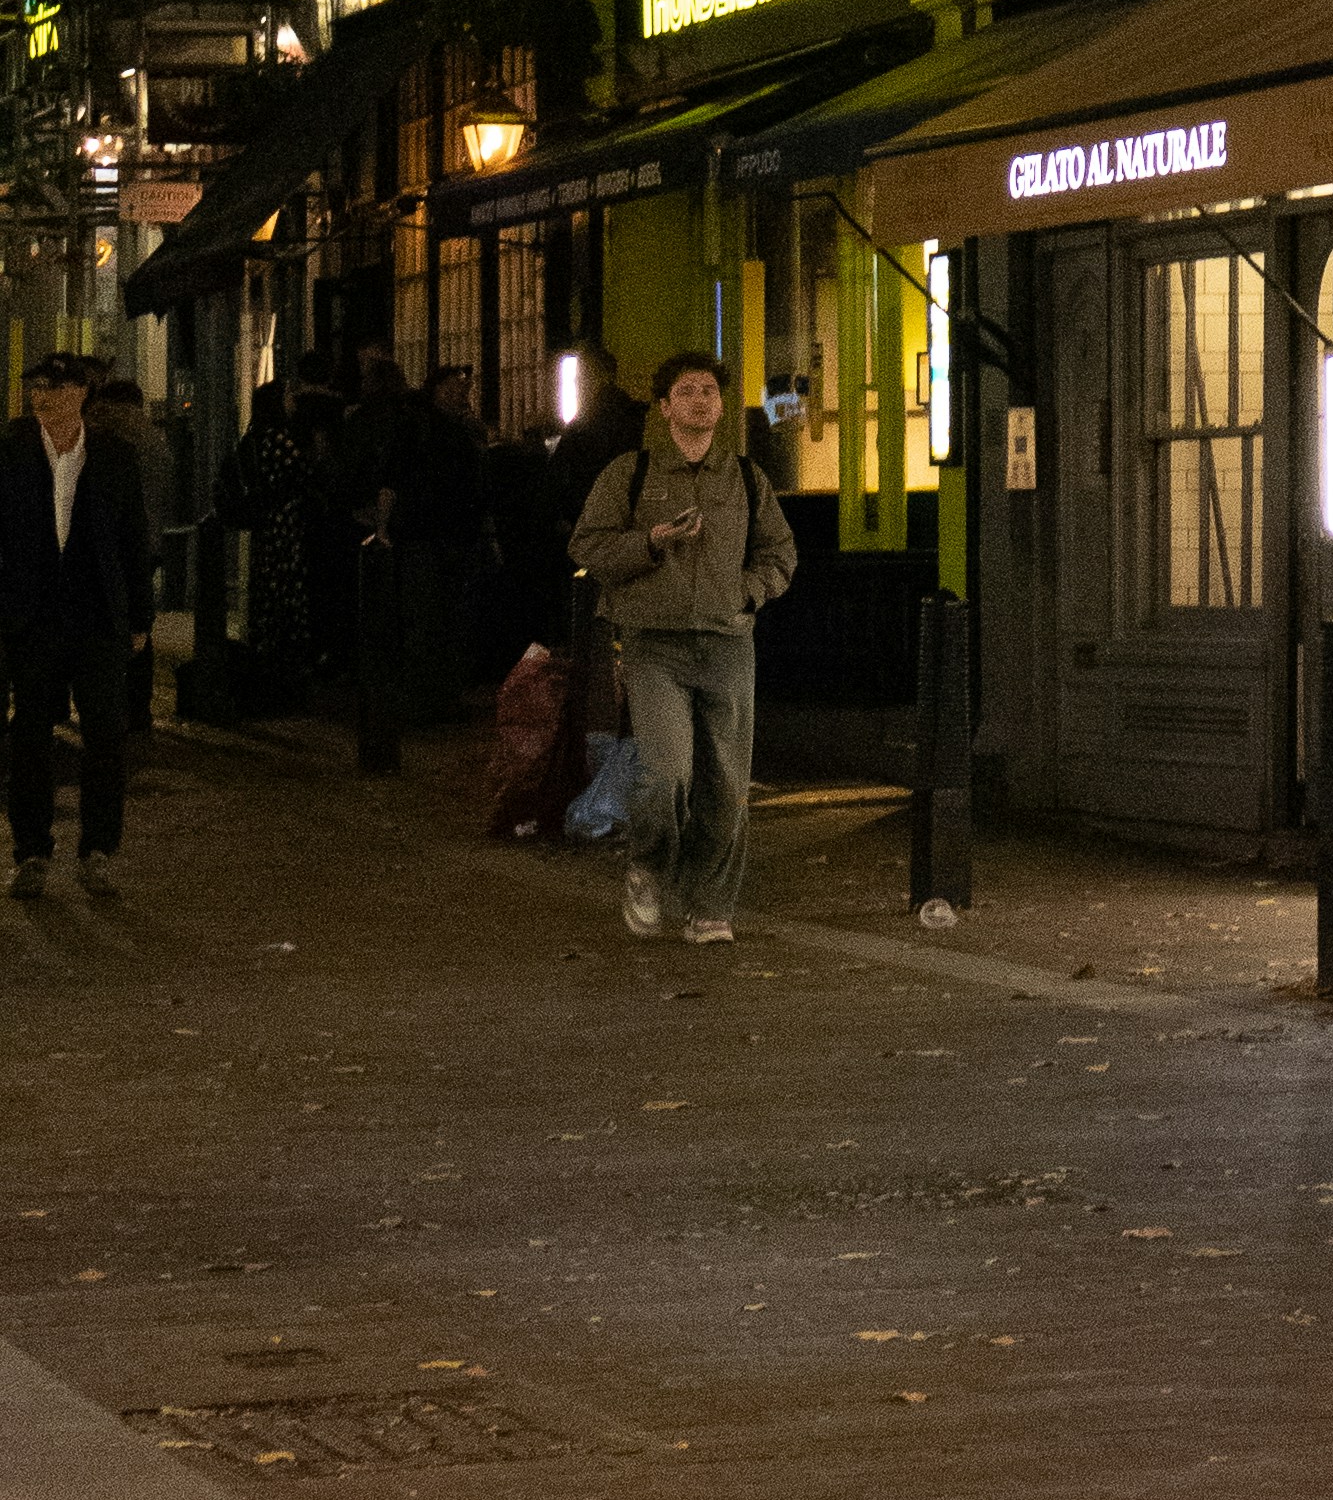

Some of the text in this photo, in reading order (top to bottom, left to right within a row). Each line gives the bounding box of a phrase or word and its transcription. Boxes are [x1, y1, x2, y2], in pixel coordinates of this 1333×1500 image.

[1009, 121, 1228, 200] GELATO AL NATURALE
